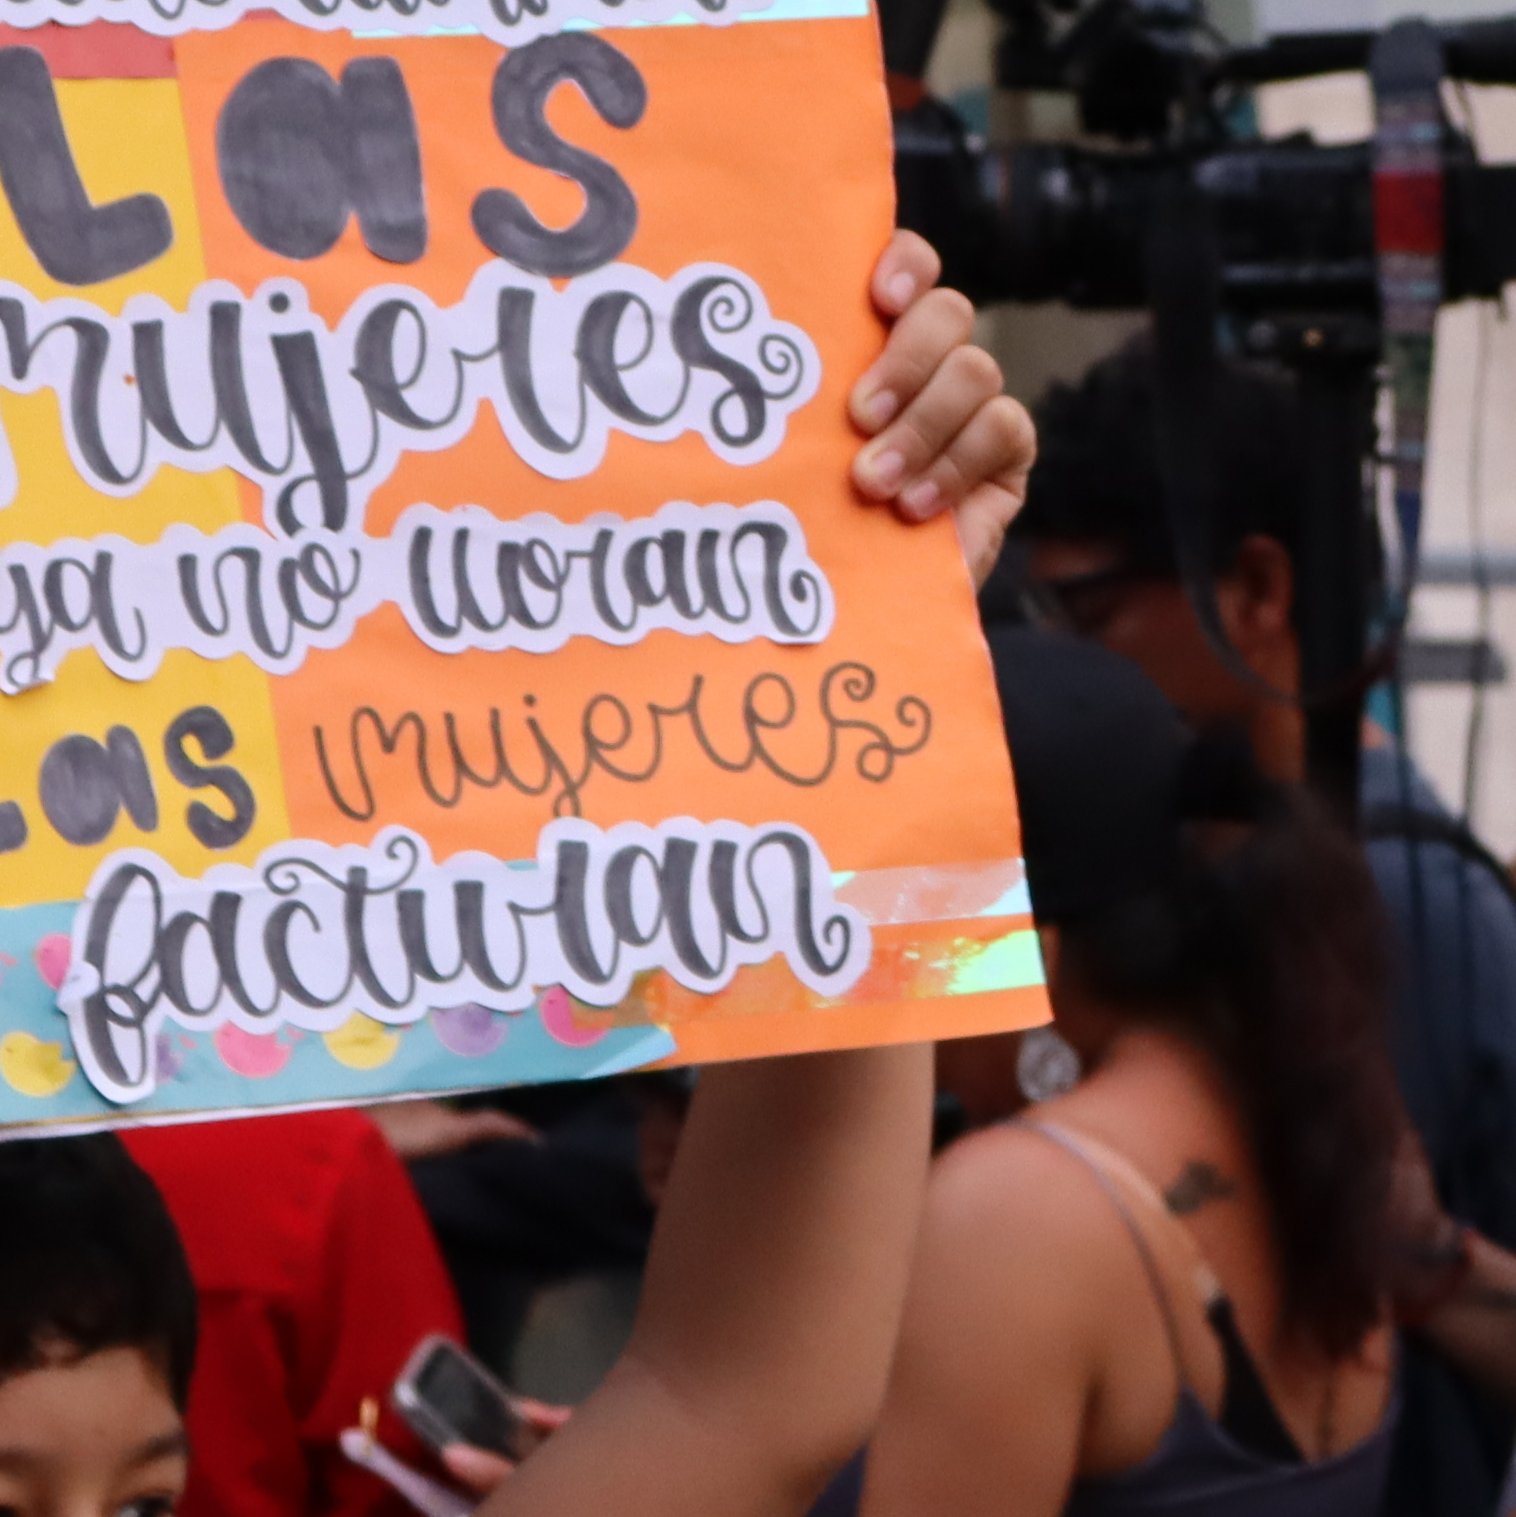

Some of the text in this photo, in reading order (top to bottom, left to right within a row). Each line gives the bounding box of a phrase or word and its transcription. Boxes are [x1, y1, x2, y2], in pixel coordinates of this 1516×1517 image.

[177, 533, 361, 661] no
[408, 521, 823, 638] lloran
[313, 661, 933, 821] mujeres
[81, 831, 852, 1089] facturan
